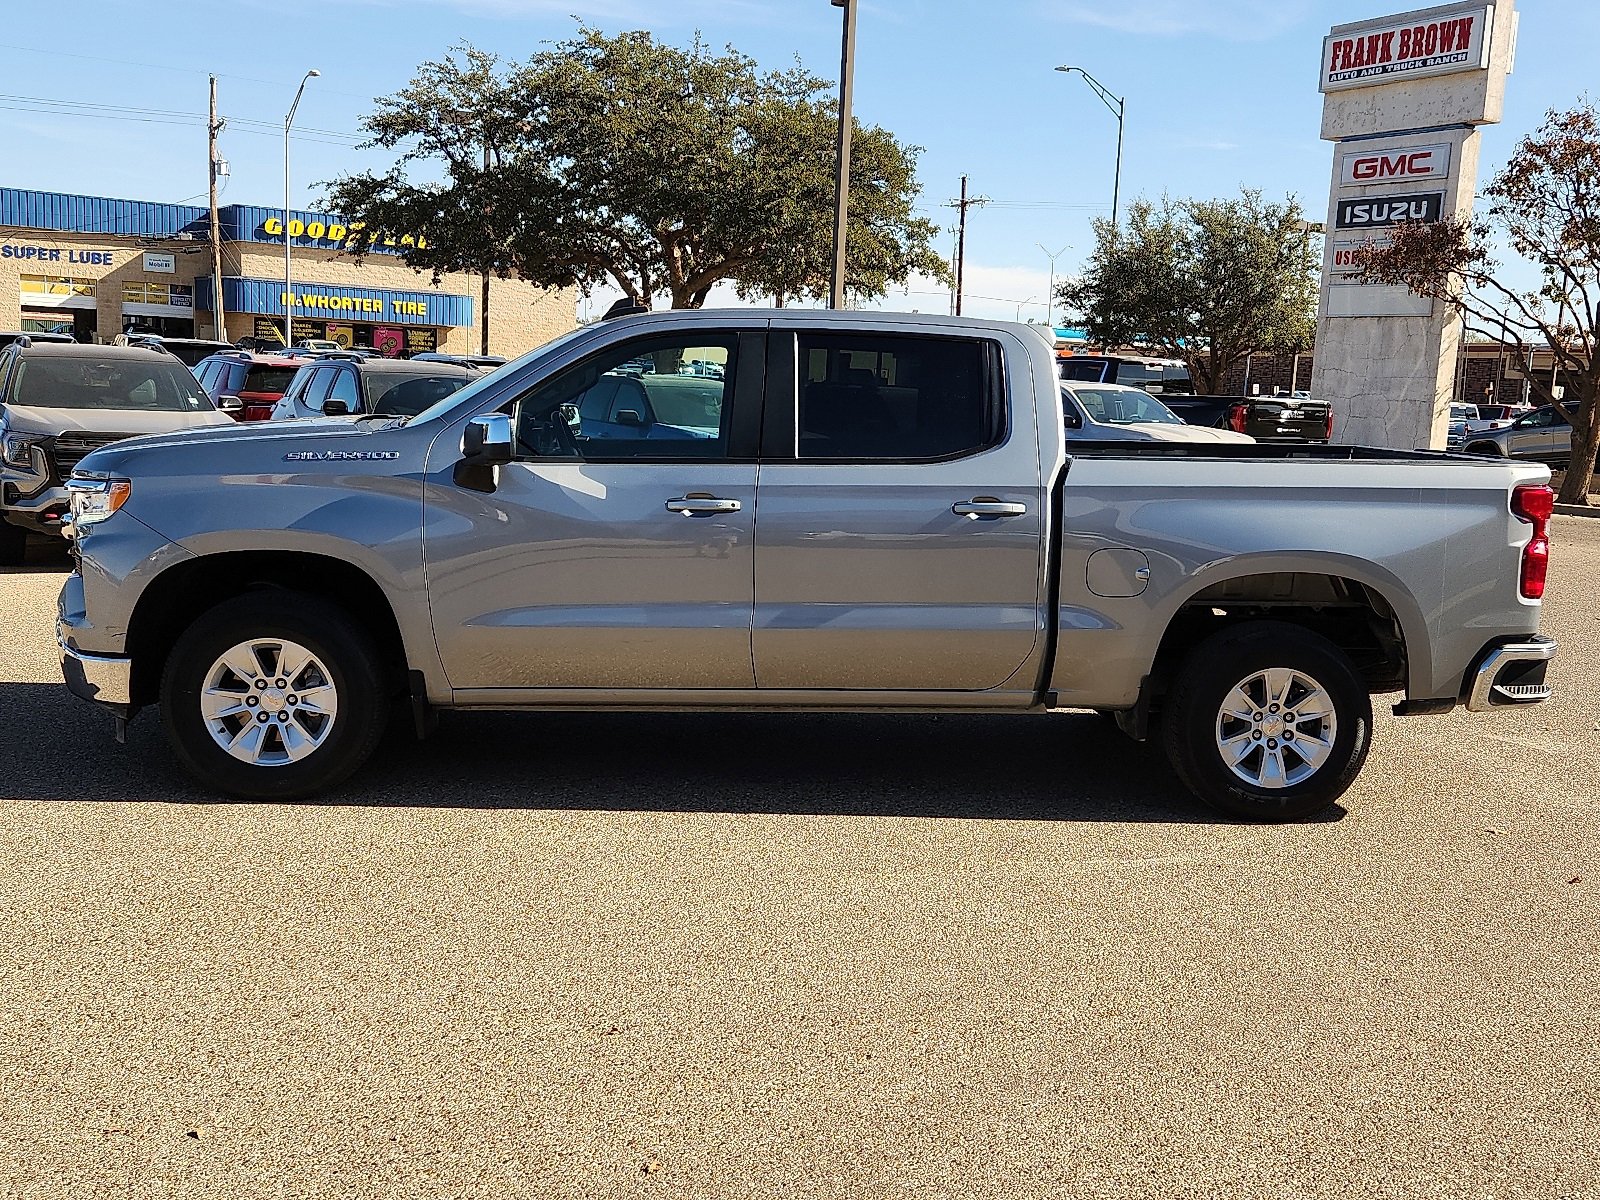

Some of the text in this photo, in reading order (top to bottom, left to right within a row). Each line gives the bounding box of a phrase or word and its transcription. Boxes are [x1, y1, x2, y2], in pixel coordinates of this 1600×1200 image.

[1330, 16, 1474, 73] FRANK BROWN
[1330, 52, 1468, 82] AUTO AND TRUCK RANCH
[1353, 151, 1432, 179] GMC
[1344, 200, 1428, 224] ISUZU
[1, 244, 113, 266] SUPER LUBE
[1335, 249, 1362, 266] USE
[281, 292, 427, 316] McWHORTER TIRE
[287, 450, 400, 460] SILVERADO
